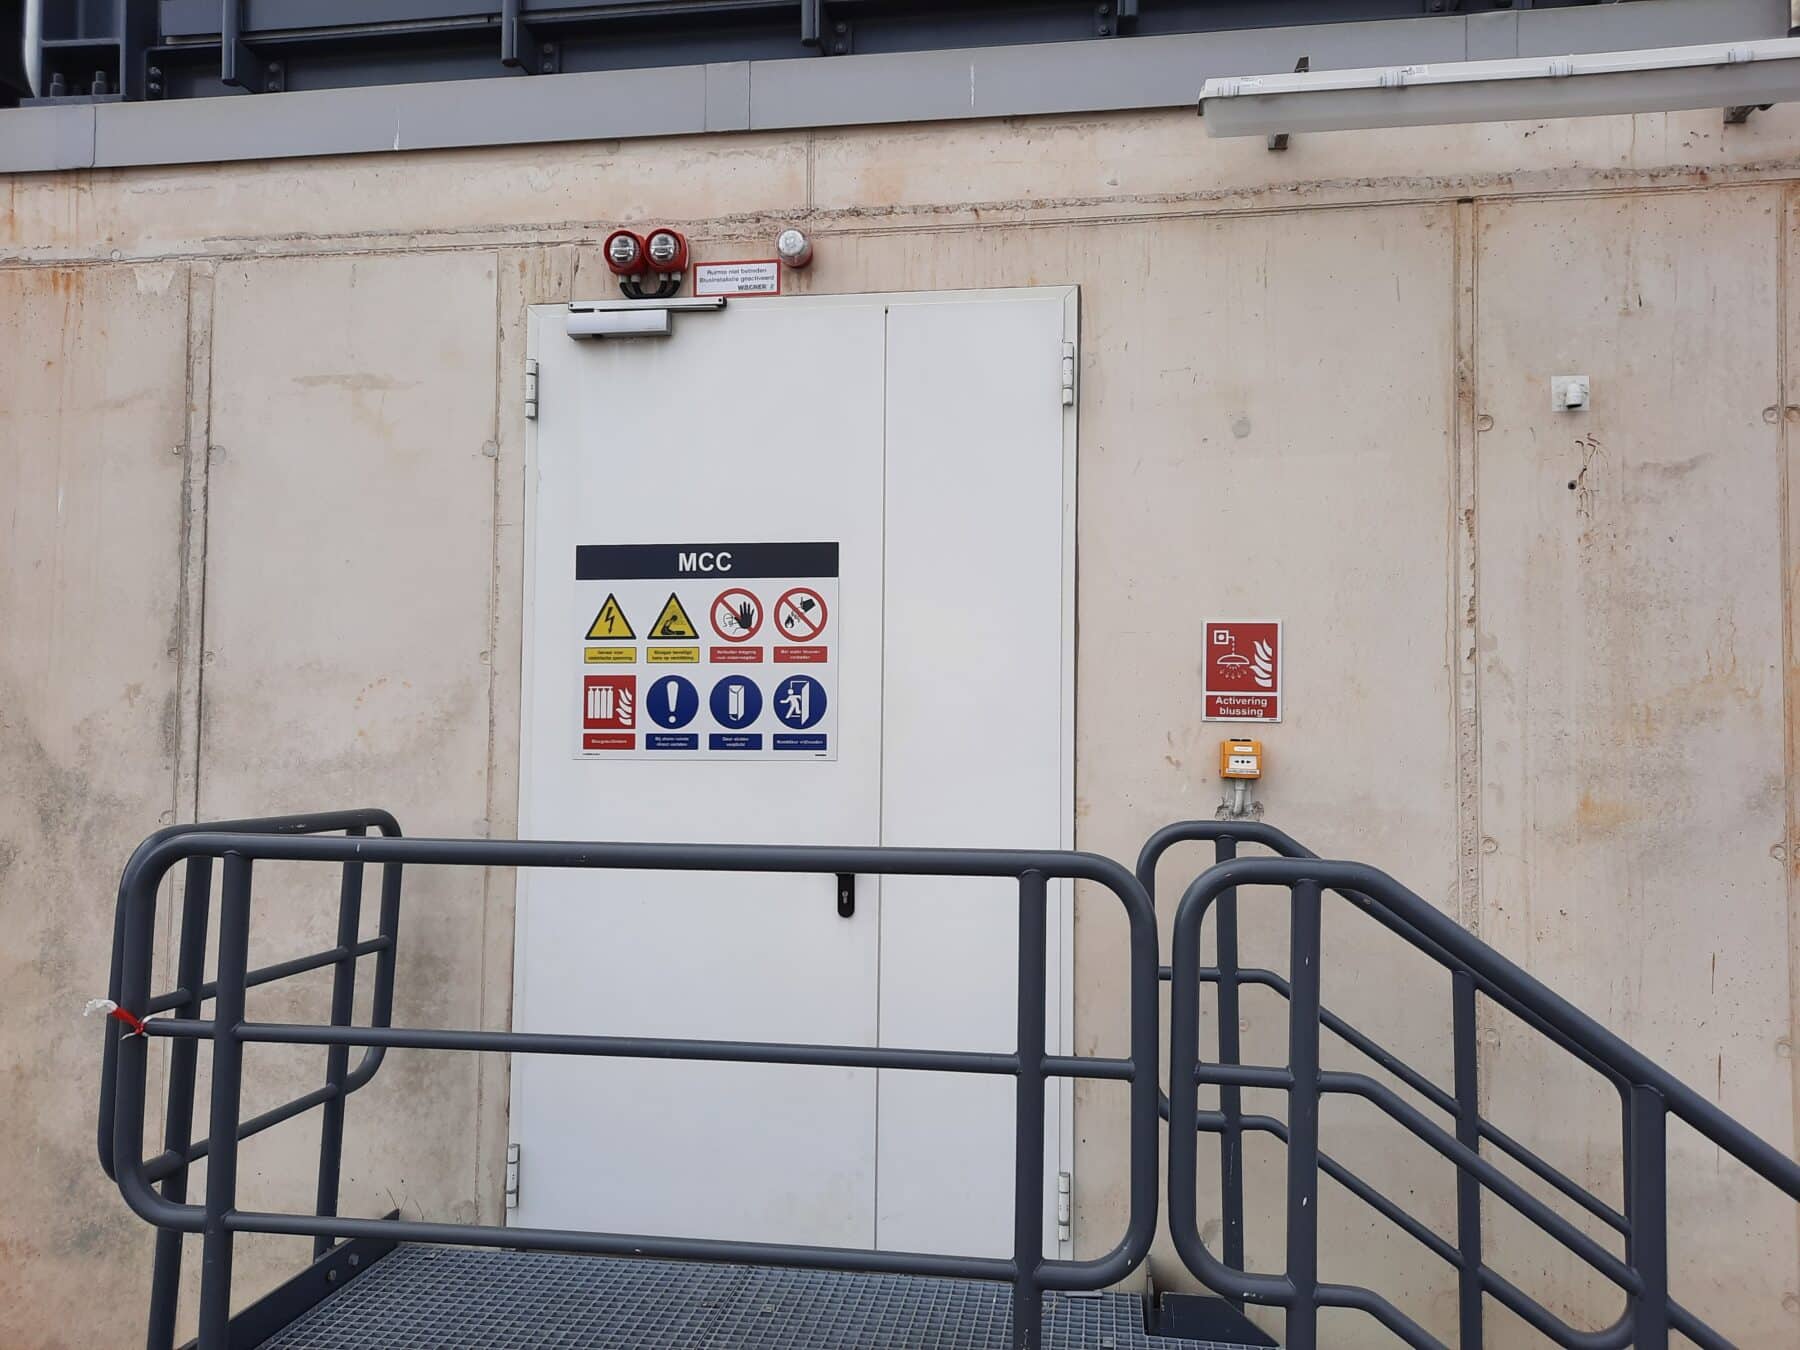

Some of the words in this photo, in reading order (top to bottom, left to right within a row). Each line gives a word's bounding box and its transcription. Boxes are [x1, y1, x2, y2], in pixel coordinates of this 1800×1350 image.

[679, 552, 732, 572] MCC
[1215, 696, 1268, 707] Activering
[1219, 707, 1264, 718] blussing
